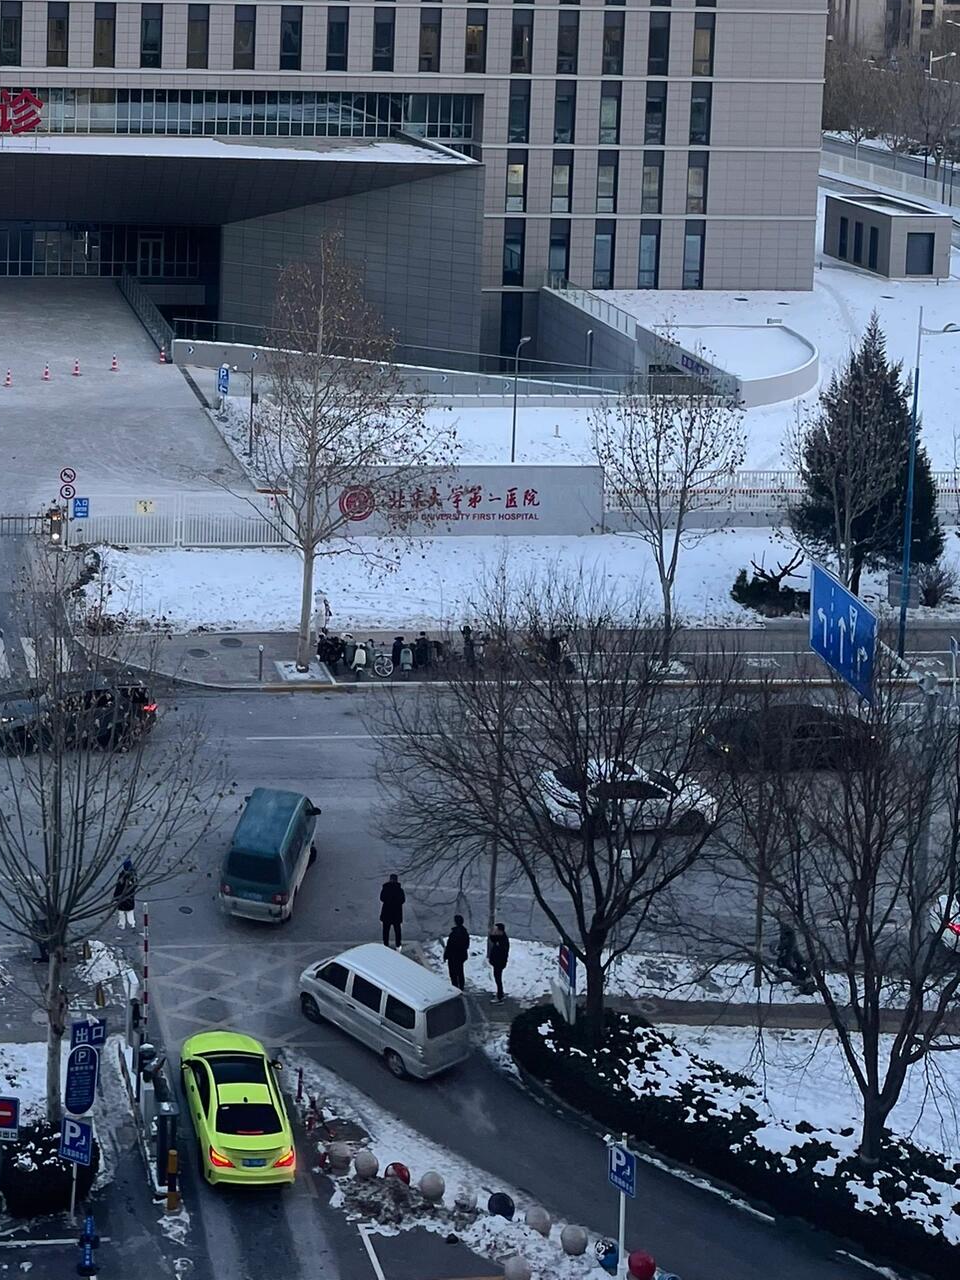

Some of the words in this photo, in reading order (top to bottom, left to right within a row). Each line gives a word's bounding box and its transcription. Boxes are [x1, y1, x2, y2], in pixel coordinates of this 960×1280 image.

[473, 513, 497, 521] FIRST
[498, 513, 540, 521] HOSPITAL
[75, 1026, 104, 1044] 出口
[78, 1051, 87, 1063] P
[65, 1120, 81, 1146] P
[611, 1146, 626, 1172] P
